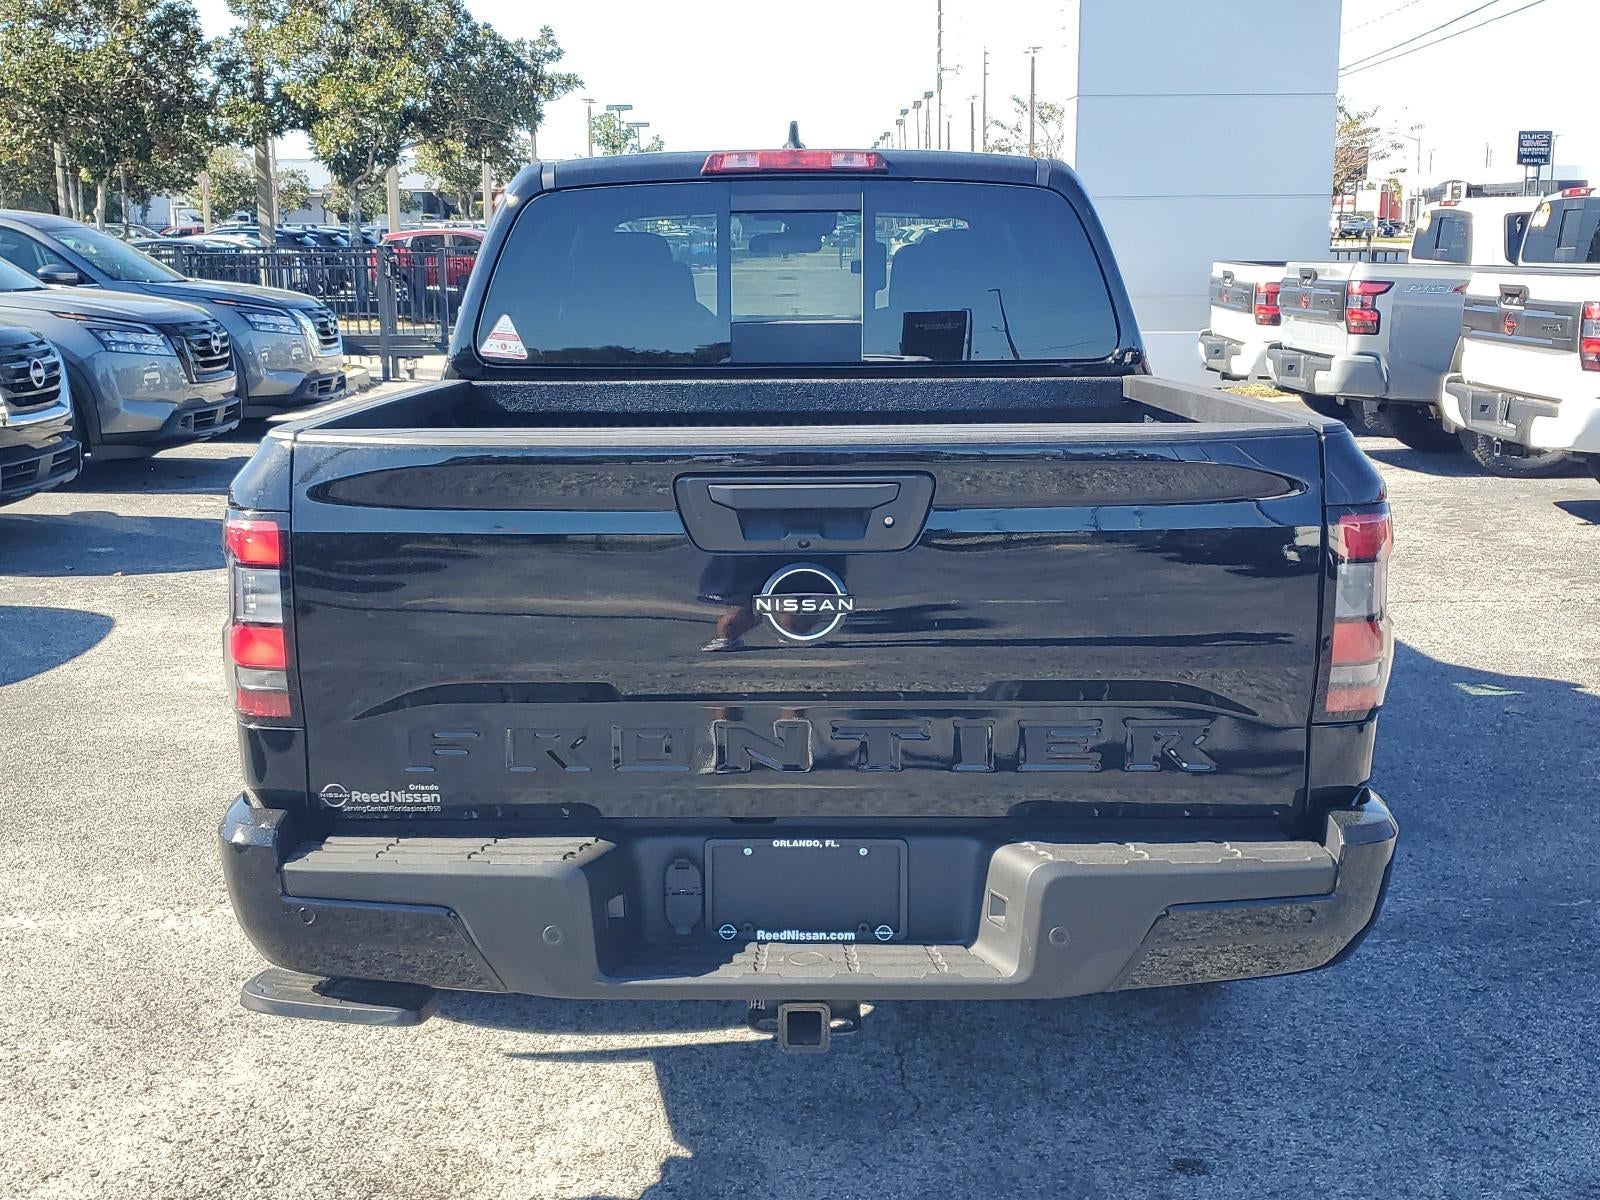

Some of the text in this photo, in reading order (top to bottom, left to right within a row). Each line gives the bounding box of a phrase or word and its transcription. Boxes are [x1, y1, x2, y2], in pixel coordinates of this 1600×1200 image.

[755, 598, 853, 612] NISSAN
[403, 718, 1217, 774] FRONTIER
[772, 839, 840, 848] ORLANDO, FL.
[756, 930, 856, 941] ReedNissan.com
